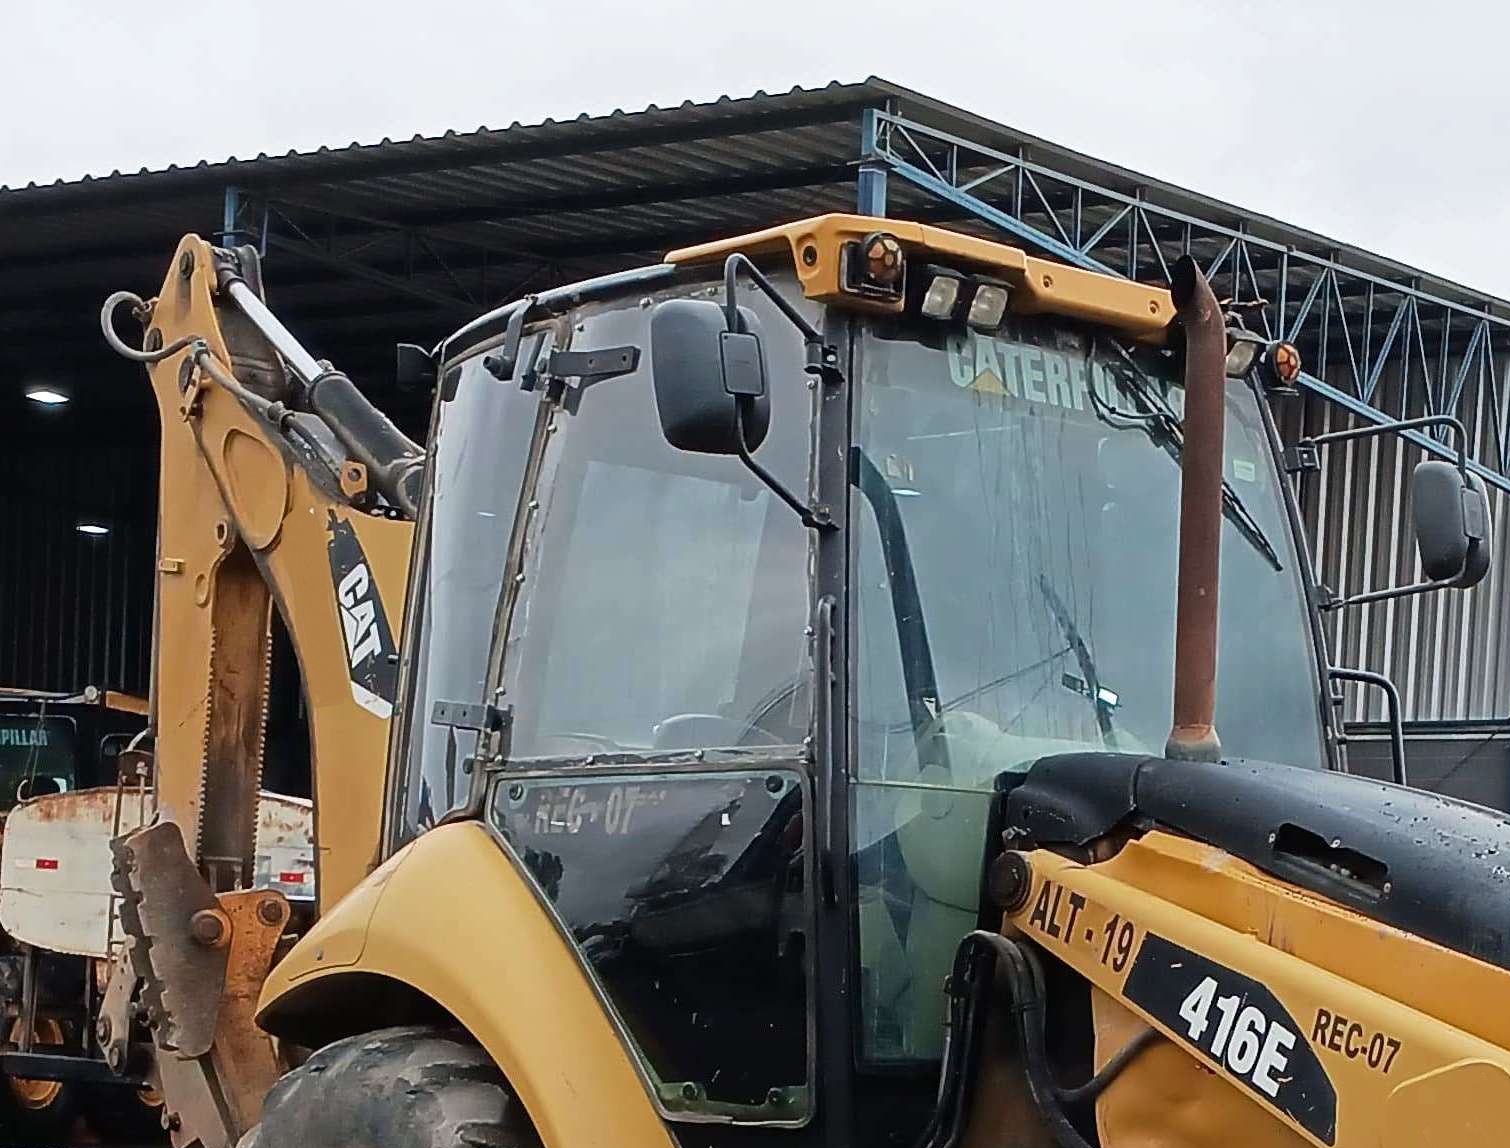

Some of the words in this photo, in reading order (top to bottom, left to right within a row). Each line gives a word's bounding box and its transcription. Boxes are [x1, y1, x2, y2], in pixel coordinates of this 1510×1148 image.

[338, 563, 382, 669] CAT
[0, 728, 48, 746] PILLAR
[1028, 880, 1087, 944] ALT
[1101, 913, 1135, 973] 19
[1178, 976, 1297, 1098] 416E
[1311, 1008, 1402, 1074] REC-07
